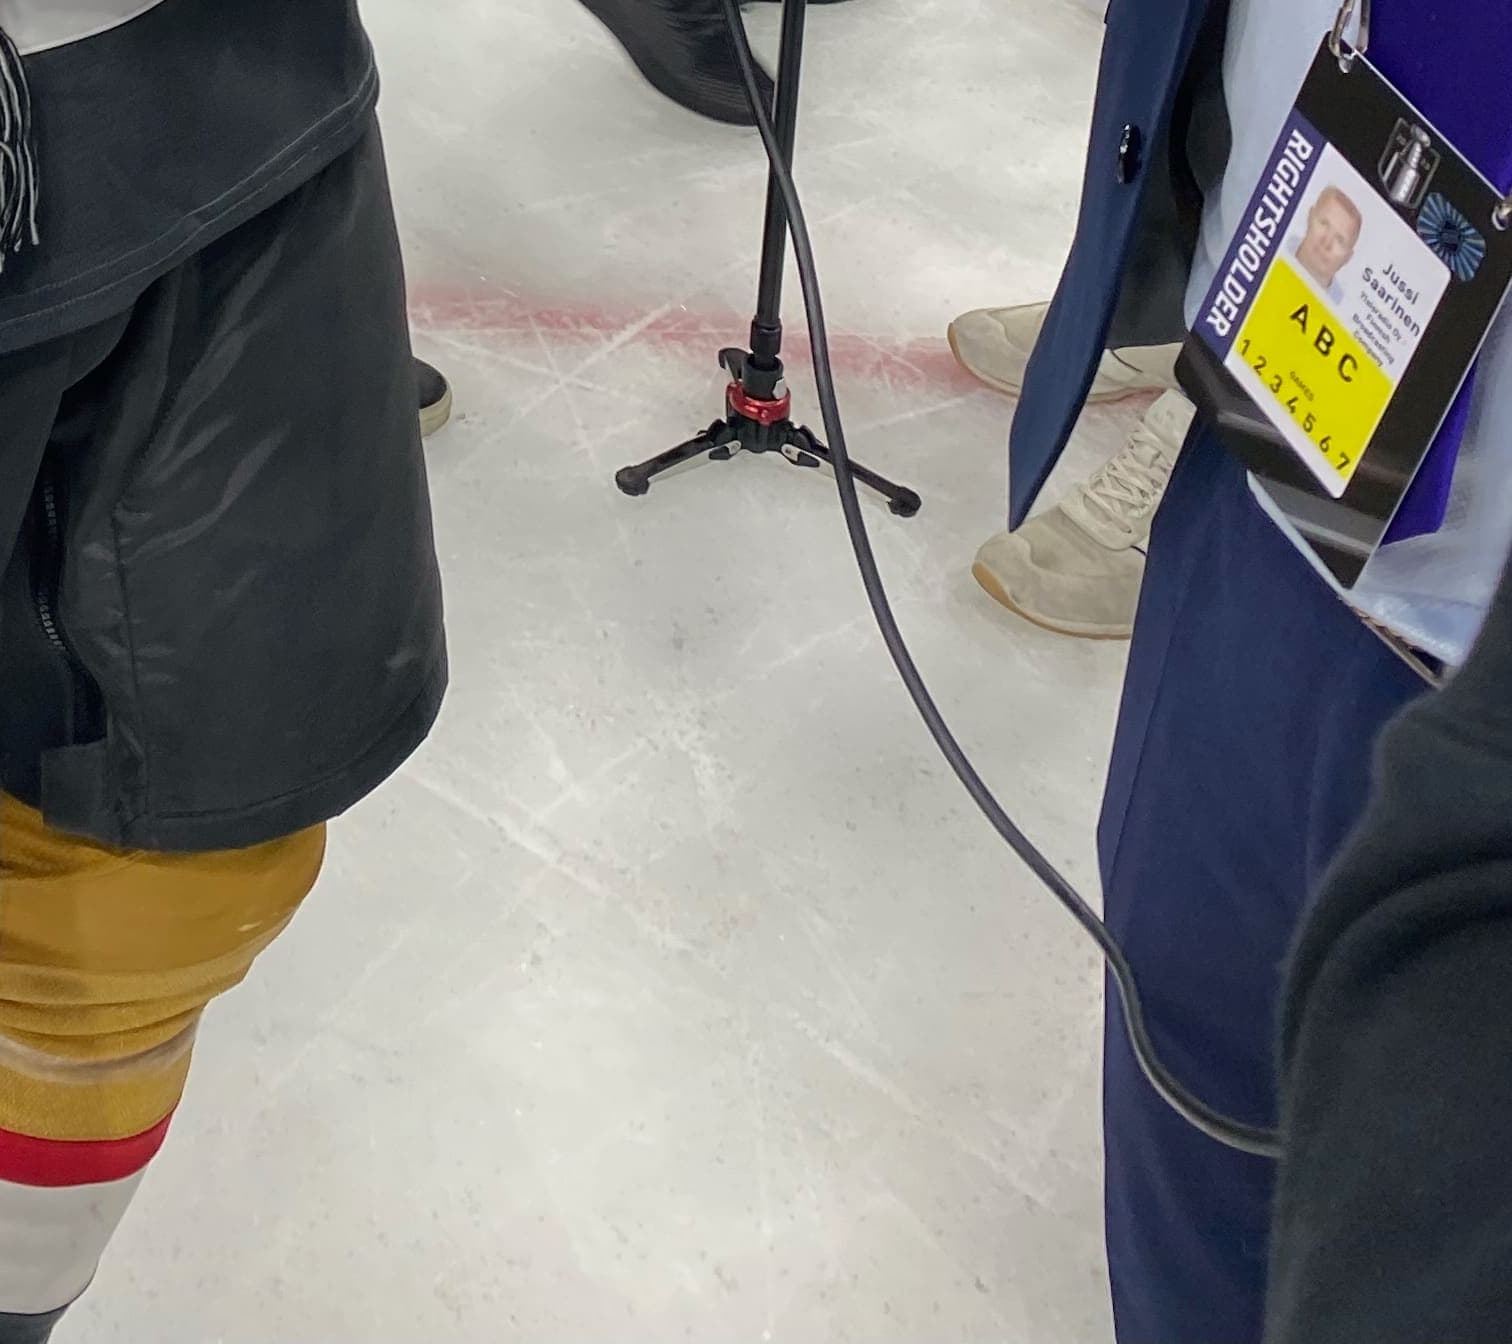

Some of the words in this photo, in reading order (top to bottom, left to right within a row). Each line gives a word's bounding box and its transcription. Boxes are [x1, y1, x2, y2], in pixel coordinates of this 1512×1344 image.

[1206, 129, 1313, 337] RIGHTSHOLDER
[1362, 267, 1420, 336] Saarinen
[1382, 264, 1419, 305] Jussi
[1290, 304, 1309, 334] A
[1313, 324, 1335, 357] B
[1338, 353, 1358, 383] C
[1241, 339, 1251, 356] 1
[1253, 355, 1267, 376] 2
[1270, 375, 1282, 393] 3
[1286, 396, 1299, 413] 4
[1302, 413, 1316, 433] 5
[1319, 435, 1331, 453] 6
[1336, 452, 1351, 470] 7
